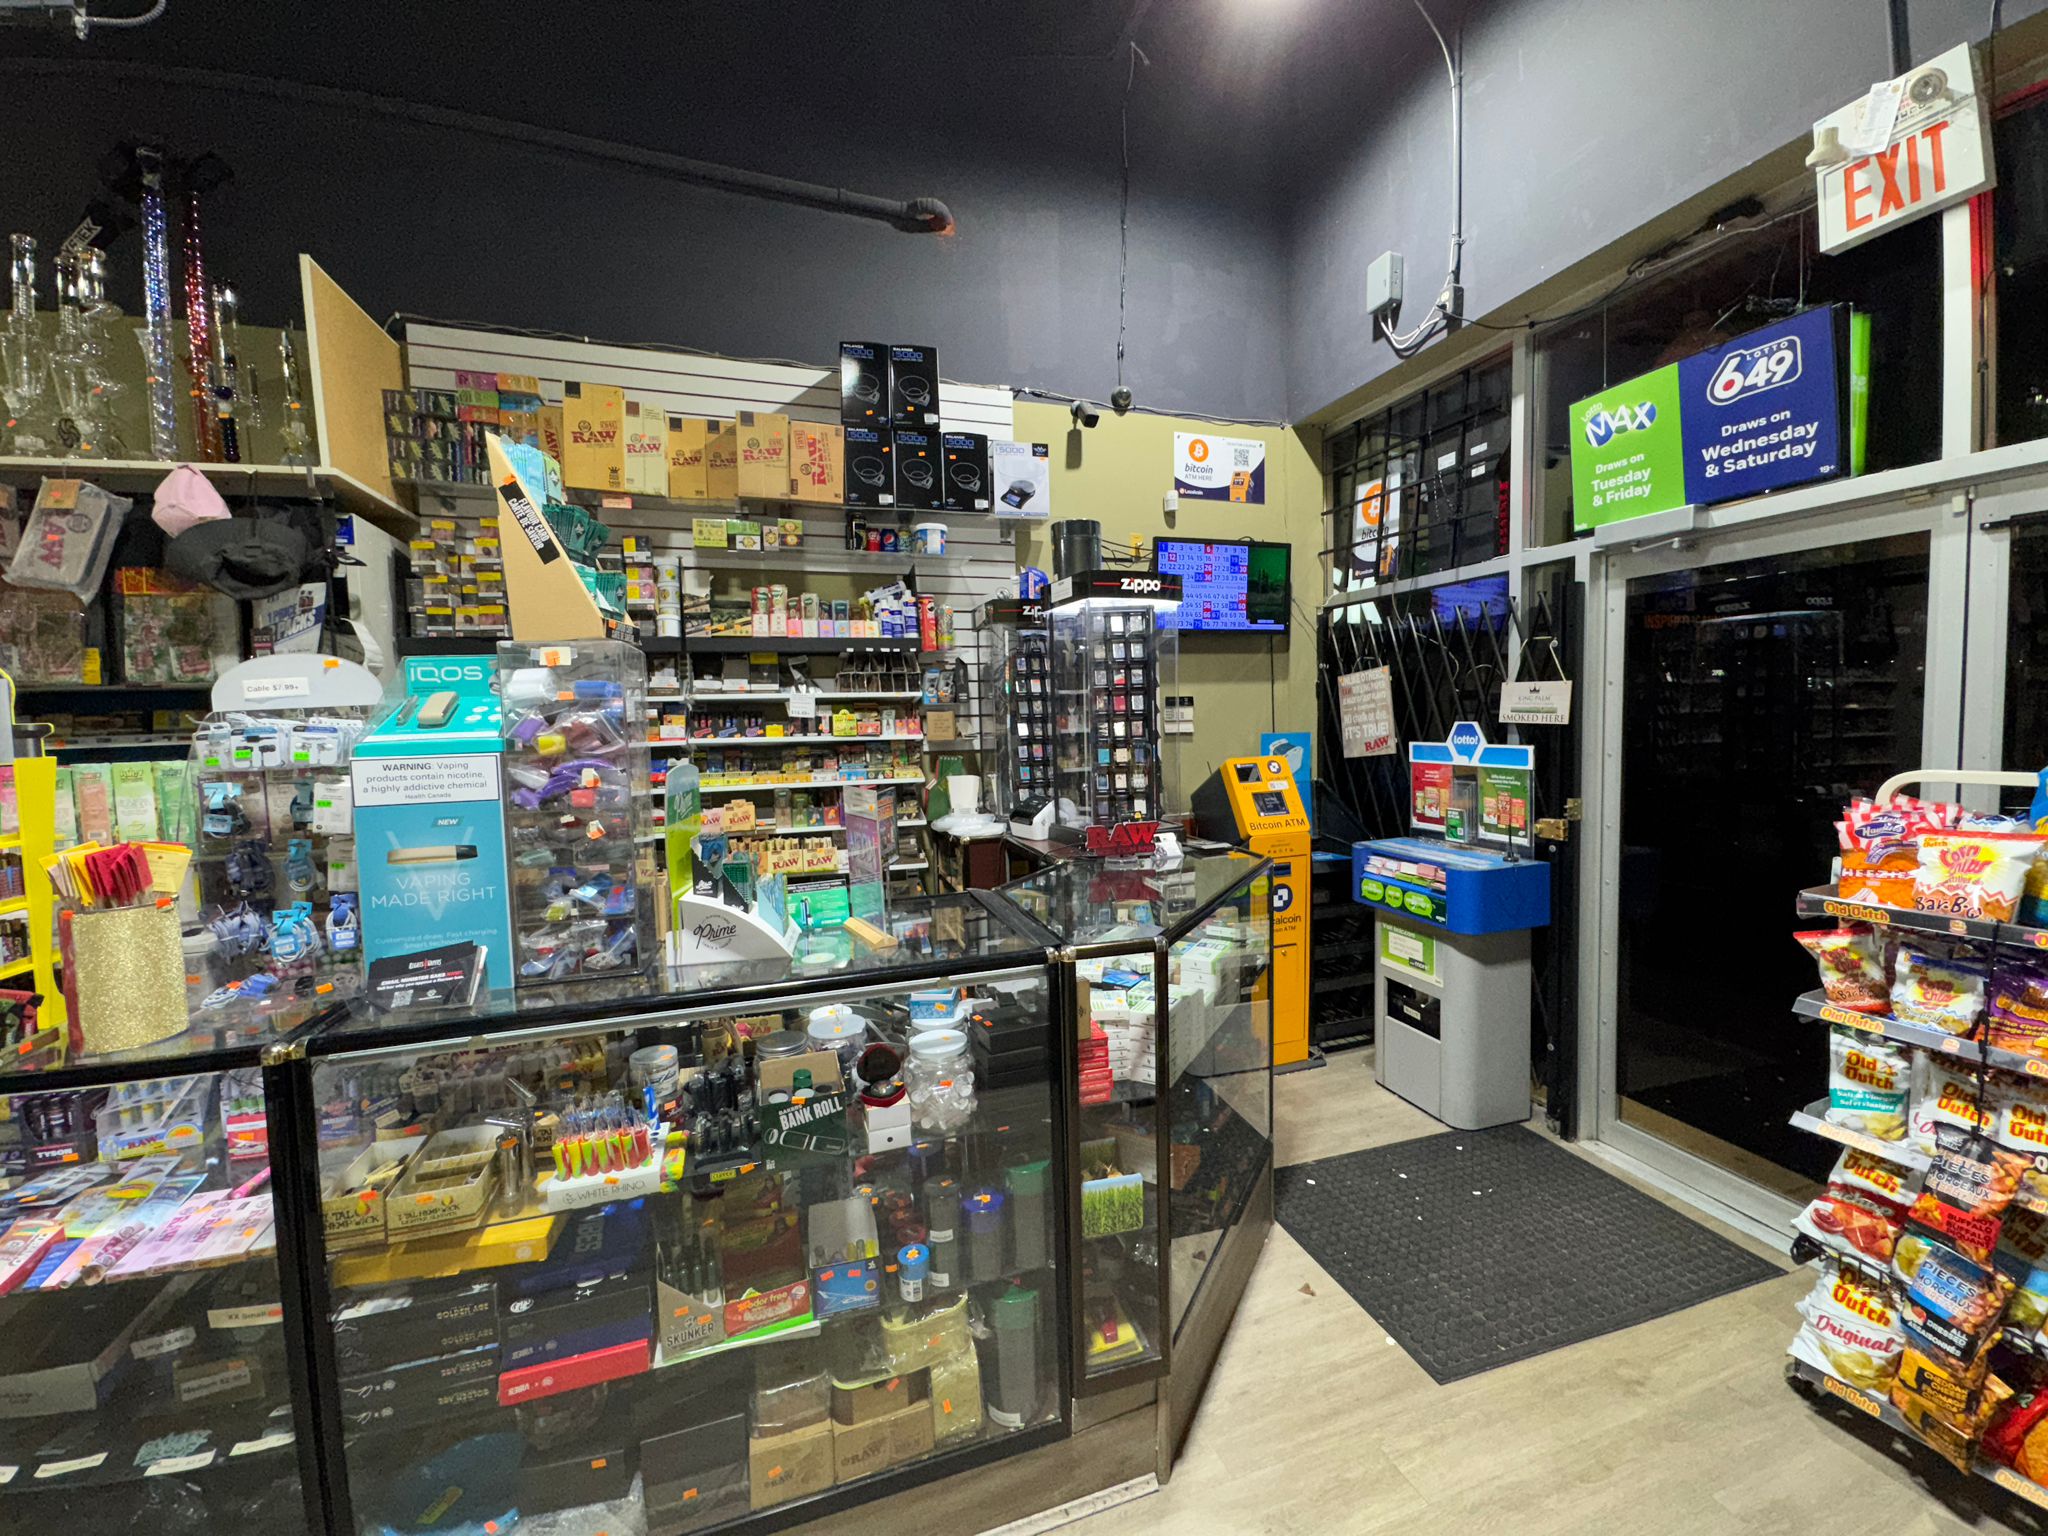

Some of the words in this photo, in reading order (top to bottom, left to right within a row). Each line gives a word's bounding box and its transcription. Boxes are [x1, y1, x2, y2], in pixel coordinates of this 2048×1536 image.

[1844, 120, 1949, 232] EXIT
[1746, 341, 1788, 360] LOTTO
[1713, 350, 1793, 400] 649
[1580, 402, 1603, 423] Lotto
[1586, 401, 1652, 447] MAX
[1722, 417, 1766, 437] Draws
[1770, 410, 1791, 423] on
[571, 431, 616, 443] RAW
[1702, 421, 1819, 462] Wednesday
[626, 443, 661, 453] RAW
[743, 448, 783, 460] RAW
[672, 455, 701, 466] RAW
[1185, 463, 1213, 474] bitcoin
[1595, 458, 1628, 475] Draws
[1630, 453, 1645, 464] on
[1705, 463, 1720, 478] &
[1723, 440, 1817, 474] Saturday
[1820, 465, 1835, 473] 19+
[1591, 468, 1651, 493] Tuesday
[1593, 495, 1603, 508] &
[1606, 484, 1652, 505] Friday
[508, 498, 523, 517] CARTE
[520, 516, 529, 529] DE
[525, 526, 544, 550] SAVEUR
[517, 497, 540, 525] FLAVOUR
[536, 523, 550, 541] CARD
[1121, 577, 1161, 593] zippo
[410, 665, 483, 683] IQOS
[247, 684, 270, 693] Cable
[1503, 714, 1539, 722] SMOKED
[1541, 715, 1565, 723] HERE
[1345, 726, 1360, 740] IT'S
[1362, 722, 1389, 737] TRUE!
[1453, 735, 1479, 745] lotto!
[1365, 735, 1389, 752] RAW
[366, 774, 408, 783] products
[410, 771, 445, 781] contain
[448, 770, 485, 779] nicotine,
[437, 761, 469, 771] Vaping
[370, 784, 401, 793] highly
[403, 782, 446, 791] addictive
[447, 781, 487, 789] chemical
[729, 814, 751, 824] RAW
[1250, 822, 1282, 831] Bitcoin
[1285, 819, 1305, 827] ATM
[1085, 822, 1160, 850] RAW
[773, 858, 799, 870] RAW
[807, 856, 833, 867] RAW
[1939, 845, 1980, 867] Corn
[396, 872, 471, 890] VAPING
[371, 894, 435, 909] MADE
[437, 886, 496, 903] RIGHT
[1824, 902, 1847, 916] Old
[1849, 905, 1889, 922] Dutch
[465, 929, 497, 937] charging
[693, 923, 737, 949] Prime
[1820, 1007, 1844, 1022] Old
[1845, 1009, 1884, 1033] Dutch
[1847, 1053, 1877, 1071] Old
[1845, 1065, 1894, 1089] Dutch
[1837, 1090, 1853, 1098] Salt
[780, 1107, 814, 1130] BANK
[813, 1097, 843, 1119] ROLL
[2012, 1104, 2046, 1126] Old
[127, 1136, 157, 1149] RAW
[2010, 1120, 2048, 1144] Dut
[37, 1148, 72, 1158] TYSON
[1844, 1153, 1898, 1193] Dutch
[1934, 1155, 1991, 1184] PIECES
[578, 1189, 608, 1201] WHITE
[612, 1181, 646, 1193] RHINO
[1929, 1169, 1990, 1199] MORCEAUX
[1946, 1220, 1992, 1241] BUFFALO
[1947, 1212, 1993, 1233] BUFFALO
[1972, 1216, 1994, 1226] HOT
[1946, 1227, 1990, 1249] PIQUANT
[1922, 1260, 1977, 1299] PIECES
[770, 1292, 787, 1306] free
[1917, 1274, 1972, 1312] MORCEAUX
[437, 1305, 470, 1319] GOLDEN
[473, 1303, 489, 1312] AGE
[1833, 1284, 1890, 1327] Dutch
[442, 1330, 475, 1345] GOLDEN
[477, 1328, 493, 1338] AGE
[667, 1322, 715, 1347] SKUNKER
[1816, 1314, 1895, 1353] Original
[1926, 1319, 1967, 1347] DRESSED
[1950, 1327, 1968, 1341] ALL
[1924, 1371, 1968, 1394] CHEDDAR
[1931, 1381, 1968, 1400] CHEESE
[1824, 1376, 1844, 1395] Old
[1848, 1390, 1880, 1417] Dutch
[851, 1437, 886, 1464] RAW
